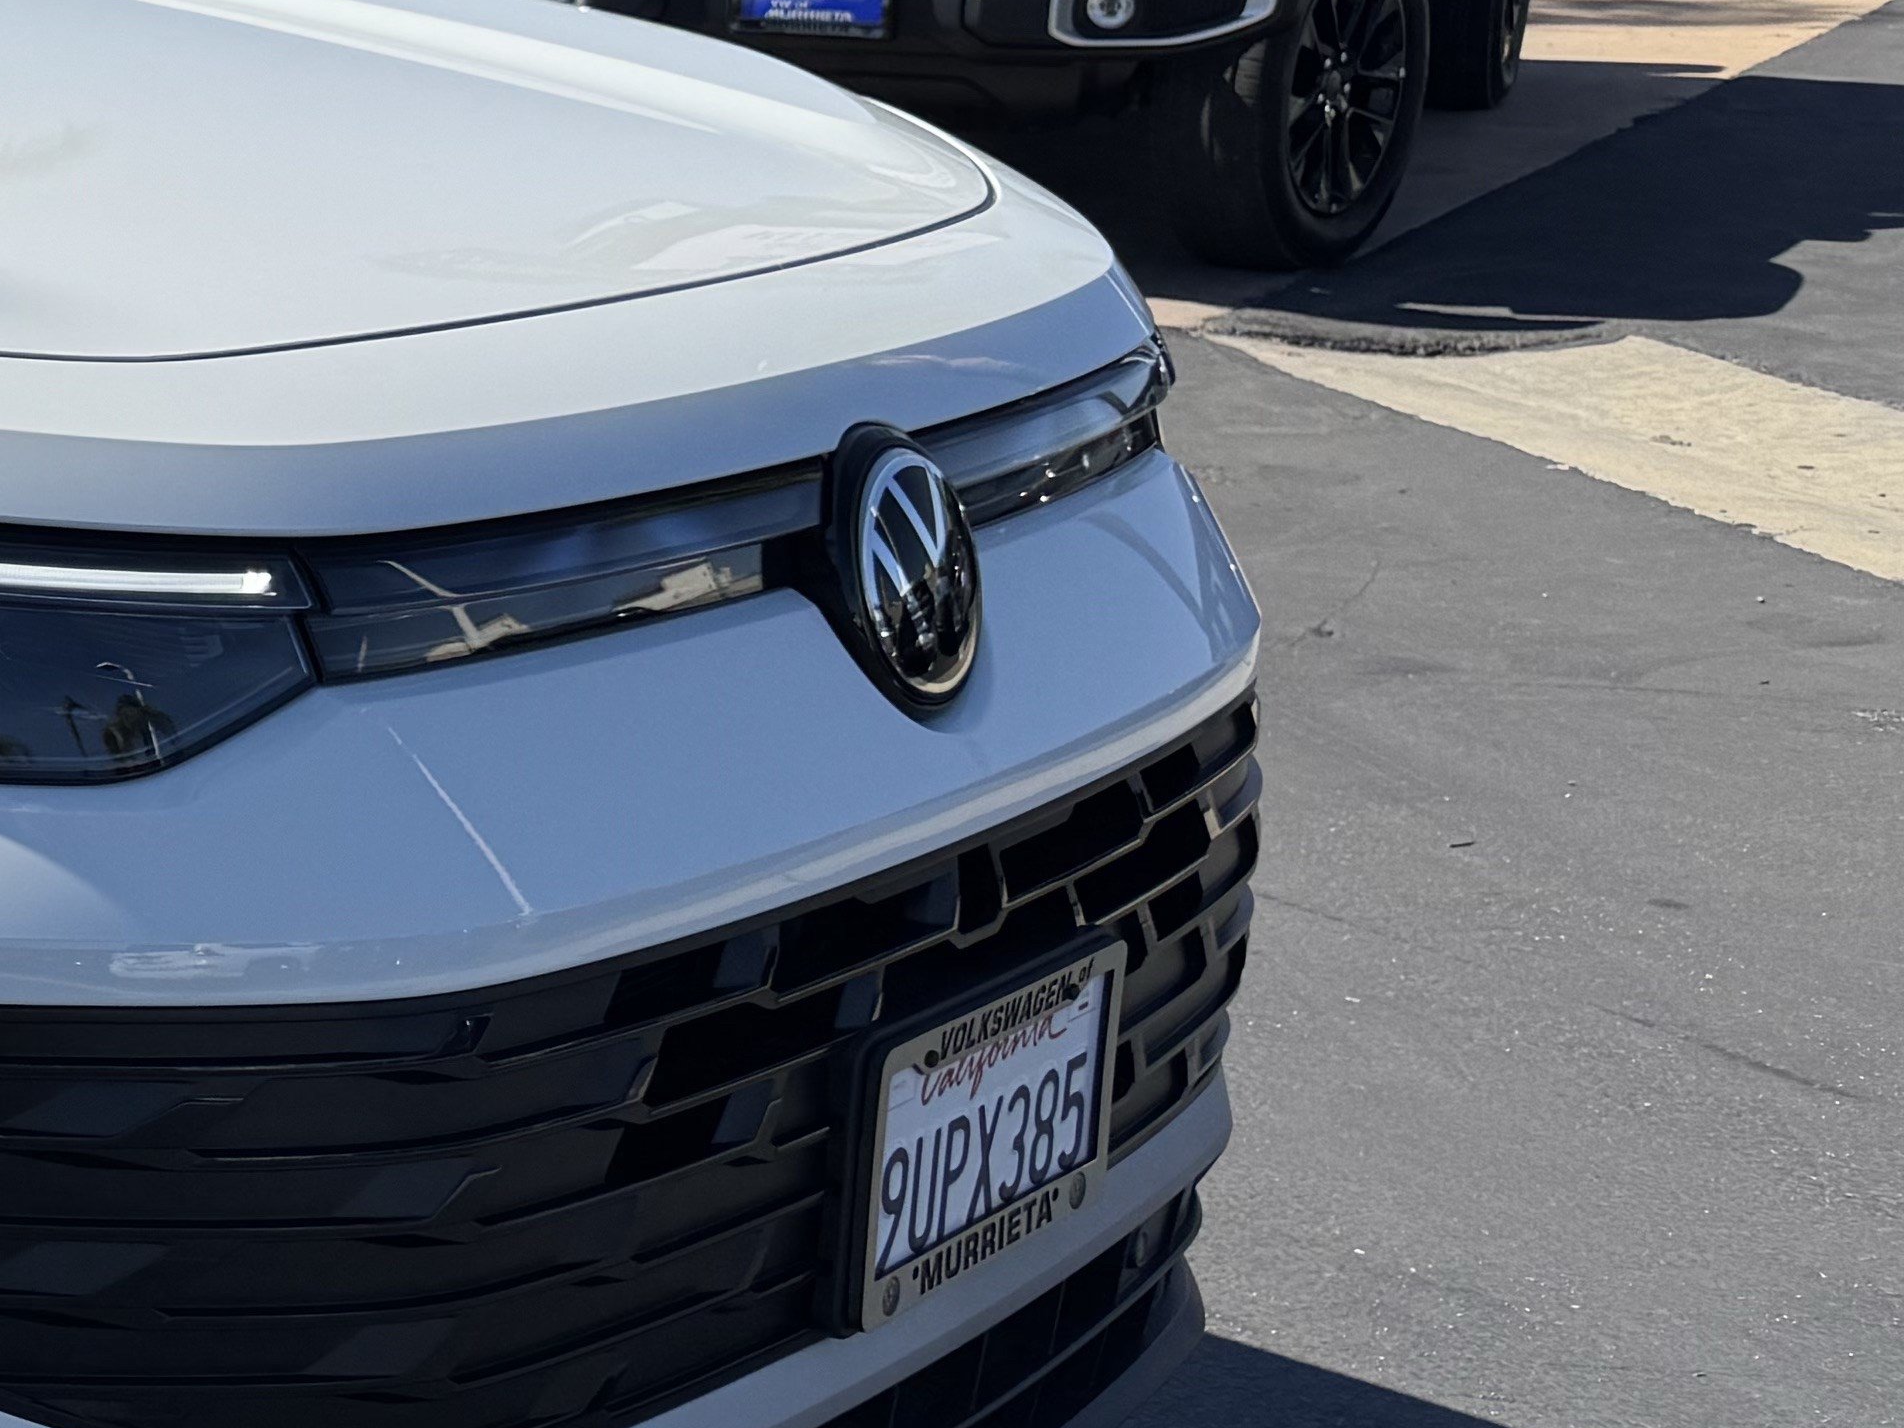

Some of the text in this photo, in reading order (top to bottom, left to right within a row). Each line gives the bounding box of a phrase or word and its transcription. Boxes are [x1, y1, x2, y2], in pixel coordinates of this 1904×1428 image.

[939, 978, 1074, 1061] VOLKSWAGEN
[874, 1051, 1088, 1282] 9UPX385
[919, 1198, 1054, 1296] MURRIETA
